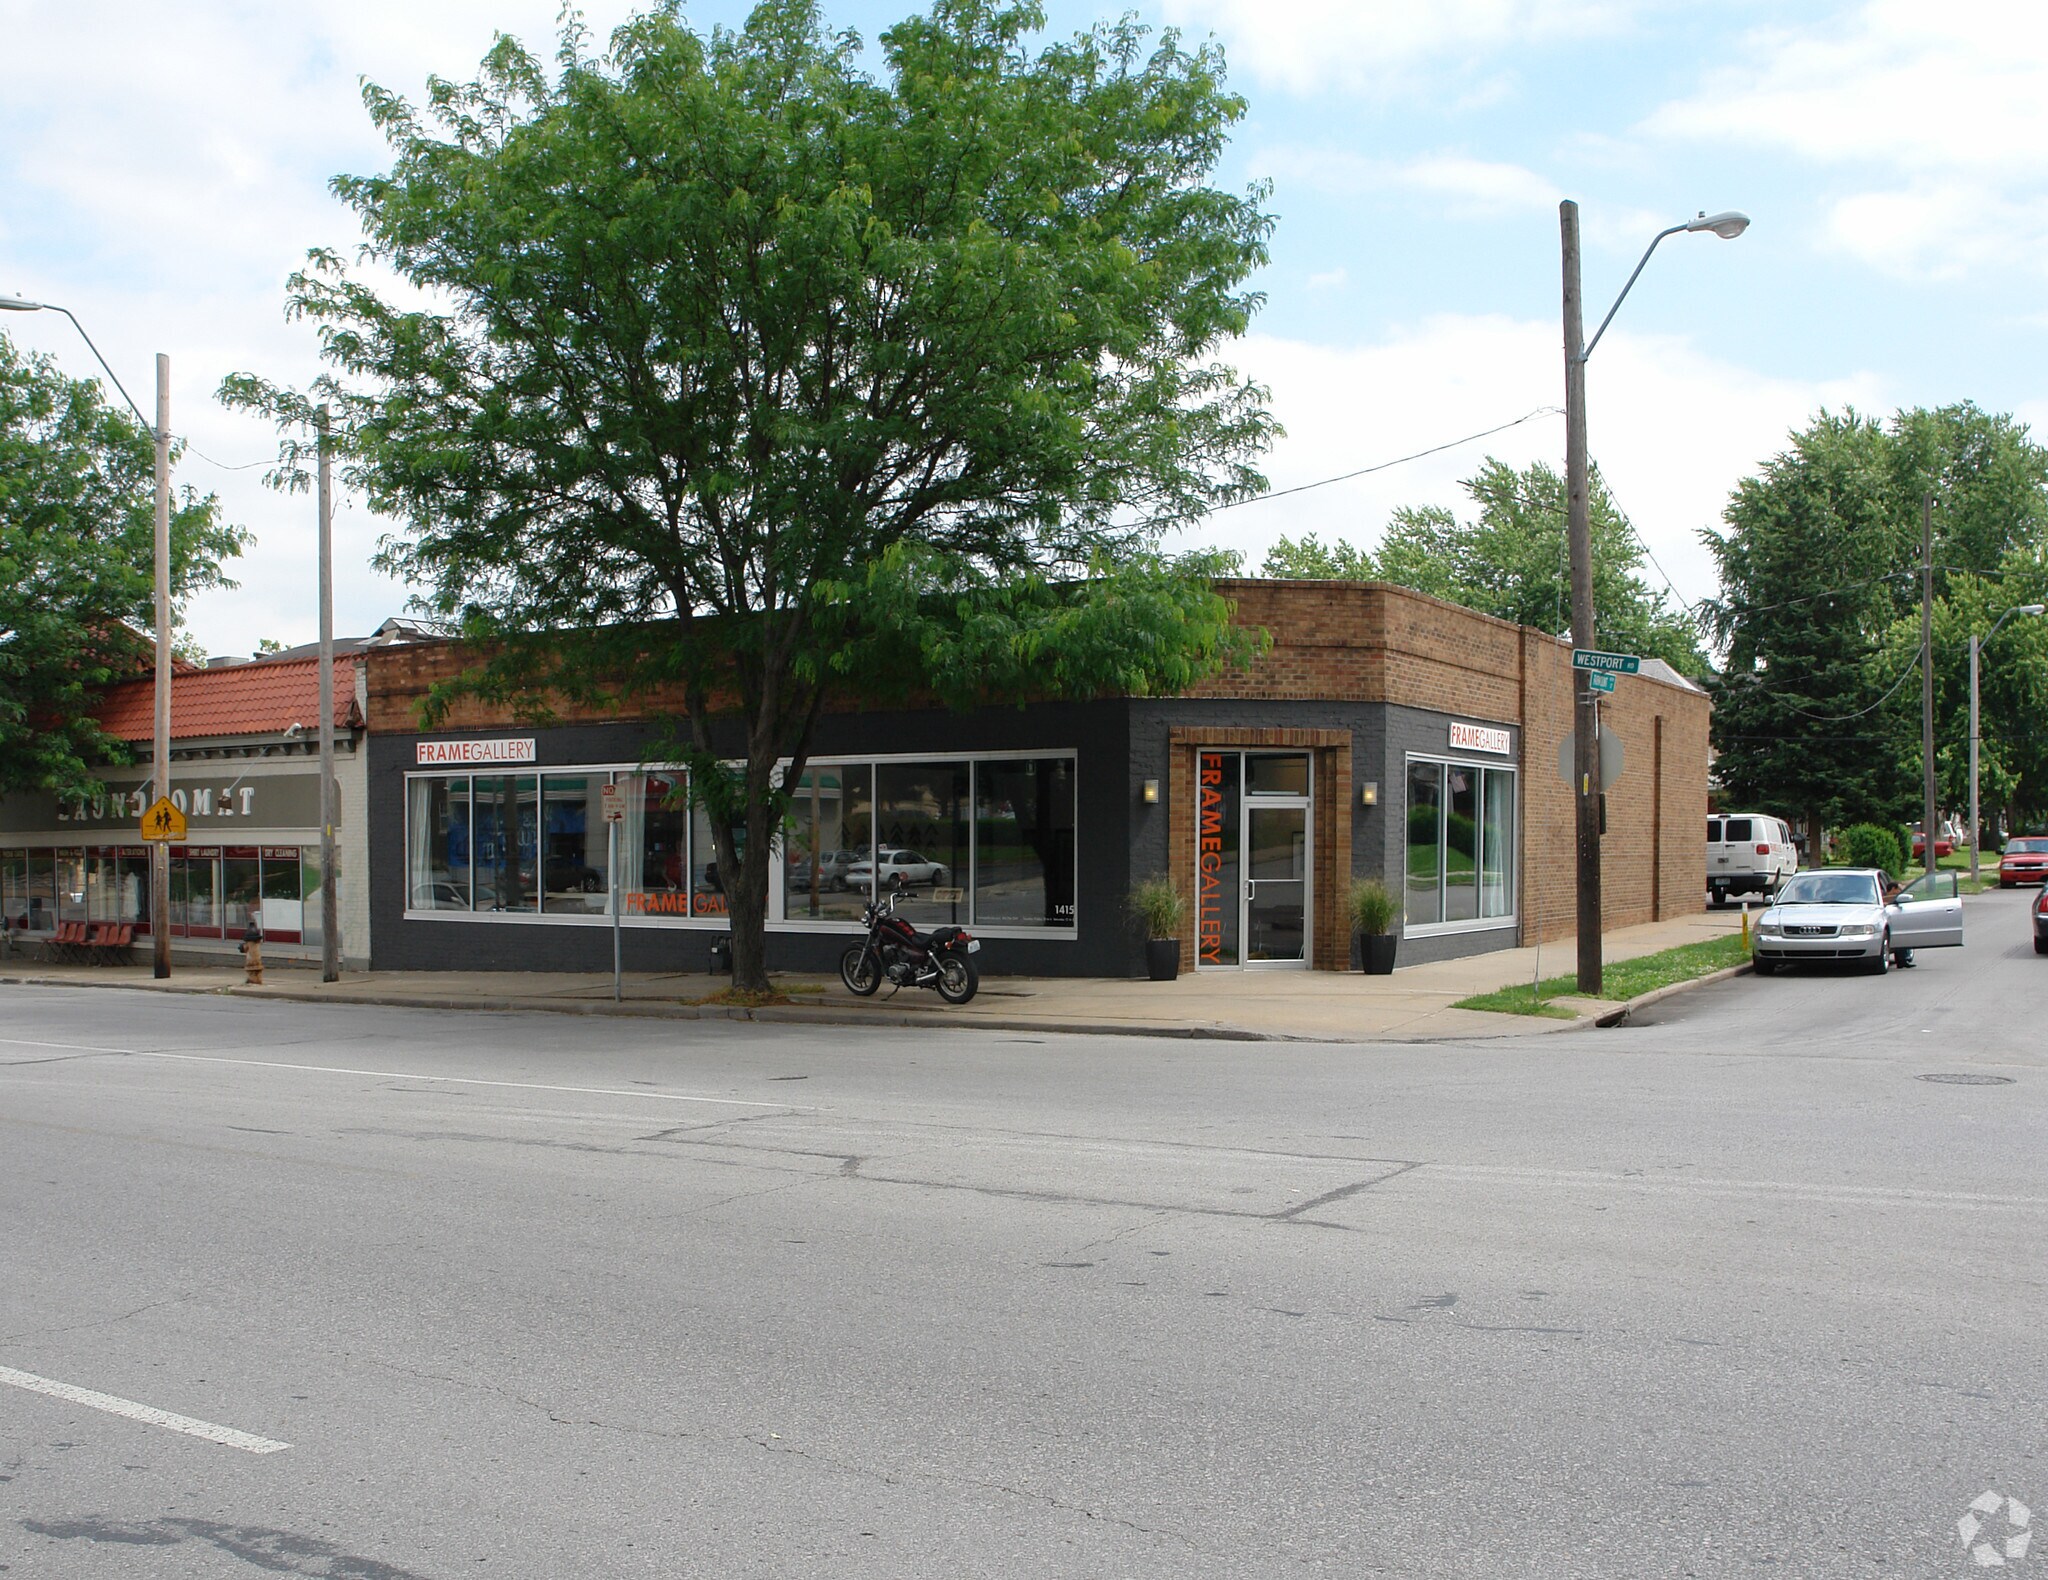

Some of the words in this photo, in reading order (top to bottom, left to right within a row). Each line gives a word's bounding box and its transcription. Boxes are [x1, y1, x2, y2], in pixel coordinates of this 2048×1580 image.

[1577, 653, 1624, 670] WESTPORT
[1451, 725, 1510, 751] FRAMEGALLERY
[418, 740, 534, 762] FRAMEGALLERY
[603, 785, 614, 795] NO
[58, 787, 255, 822] AUNDOMAT
[1200, 753, 1222, 964] FRAMEGALLERY
[626, 893, 687, 913] FRAME
[1055, 905, 1074, 915] 1415
